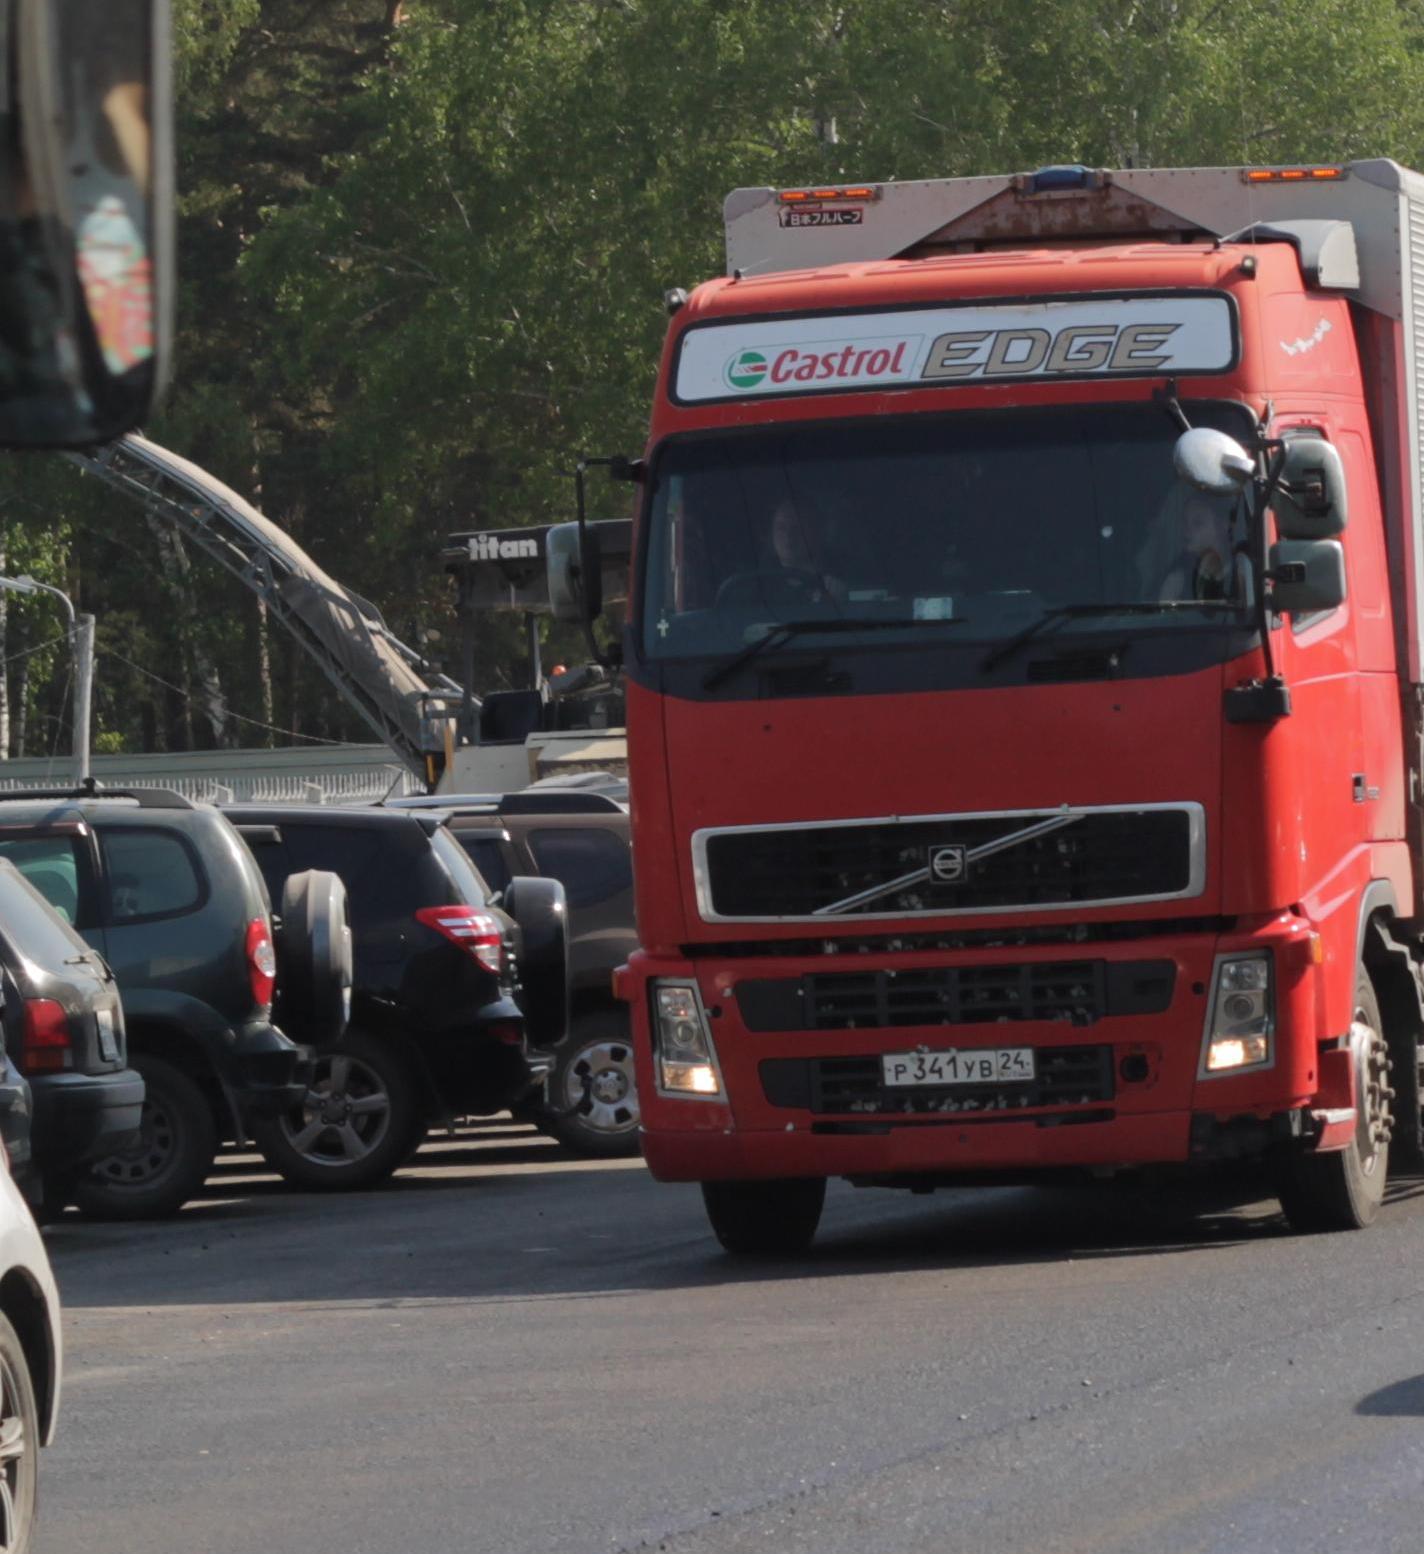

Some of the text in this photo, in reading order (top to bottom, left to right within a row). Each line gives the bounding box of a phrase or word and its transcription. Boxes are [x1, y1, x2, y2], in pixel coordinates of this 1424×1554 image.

[770, 323, 1185, 384] Castrol EDGE
[468, 533, 538, 561] titan
[1001, 1052, 1026, 1070] 24
